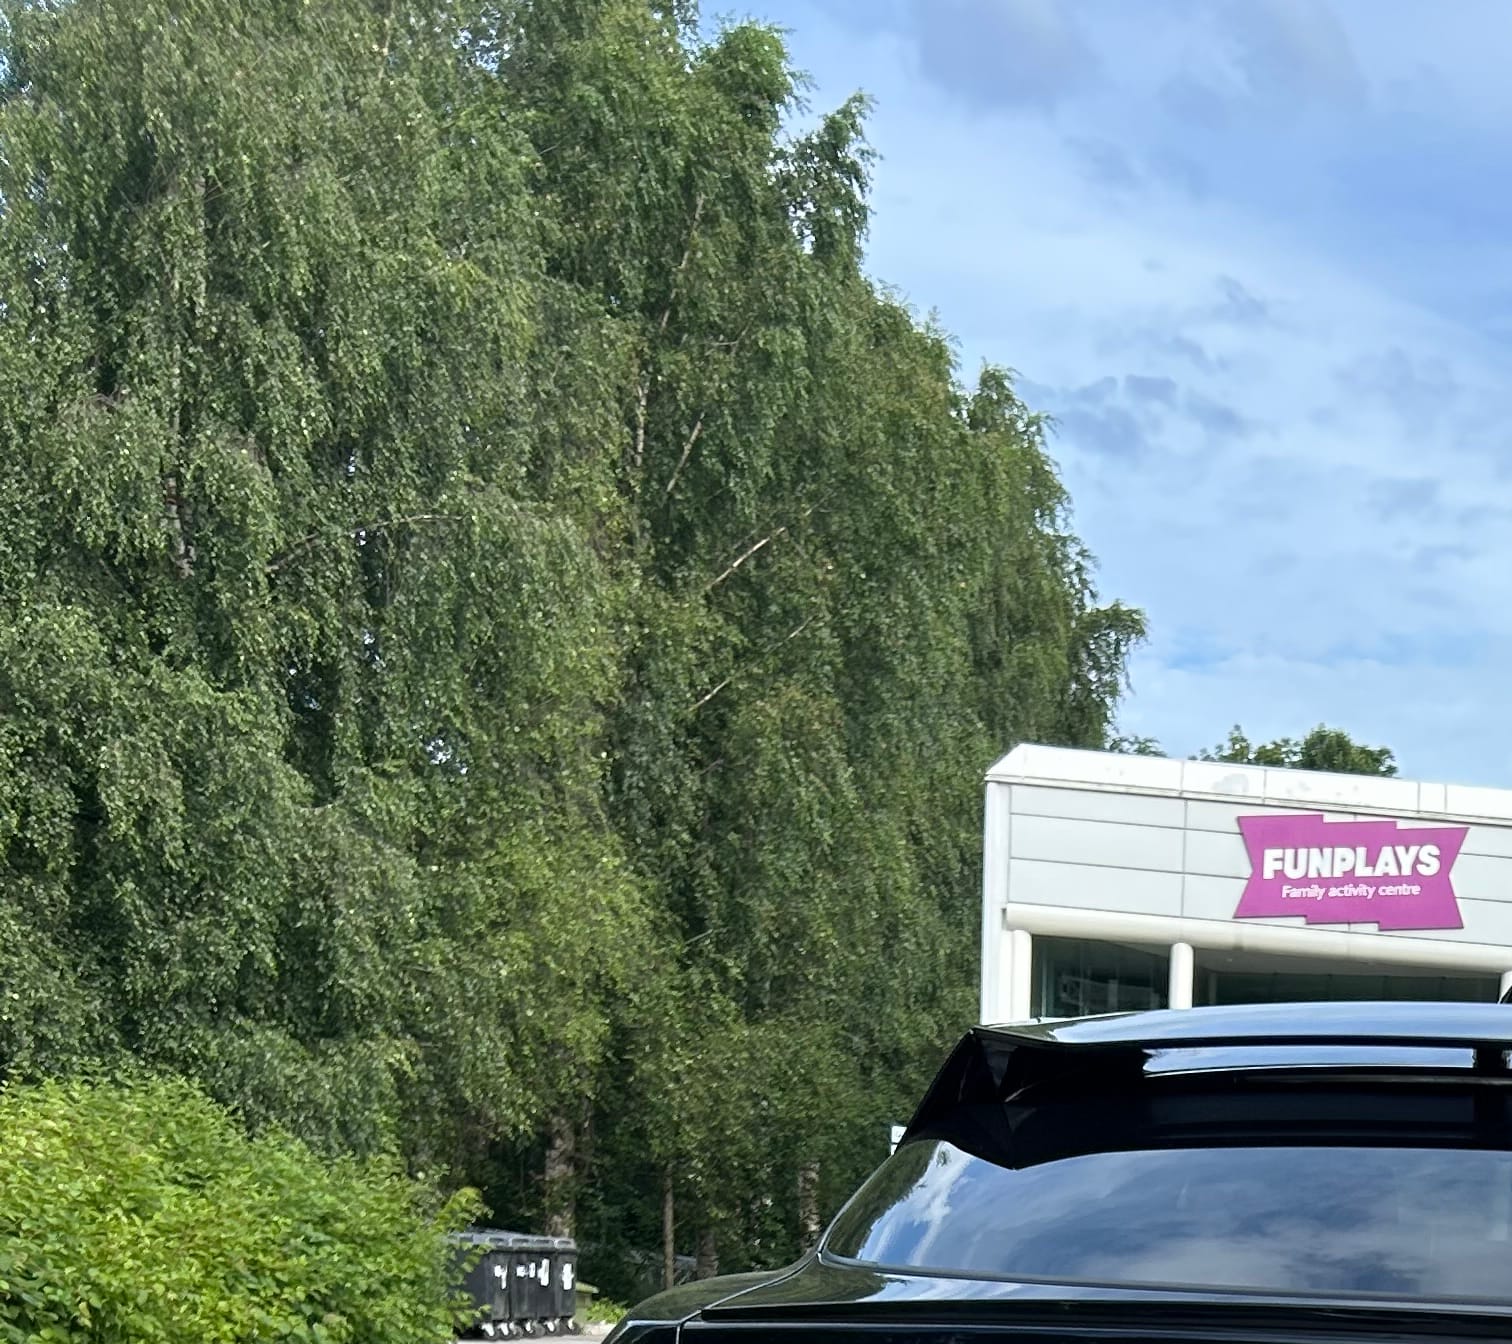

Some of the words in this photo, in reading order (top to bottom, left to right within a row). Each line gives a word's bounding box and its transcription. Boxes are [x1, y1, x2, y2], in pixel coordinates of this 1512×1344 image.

[1263, 845, 1441, 880] FUNPLAYS
[1282, 884, 1326, 900] Family
[1328, 884, 1376, 899] activity
[1378, 883, 1421, 897] centre
